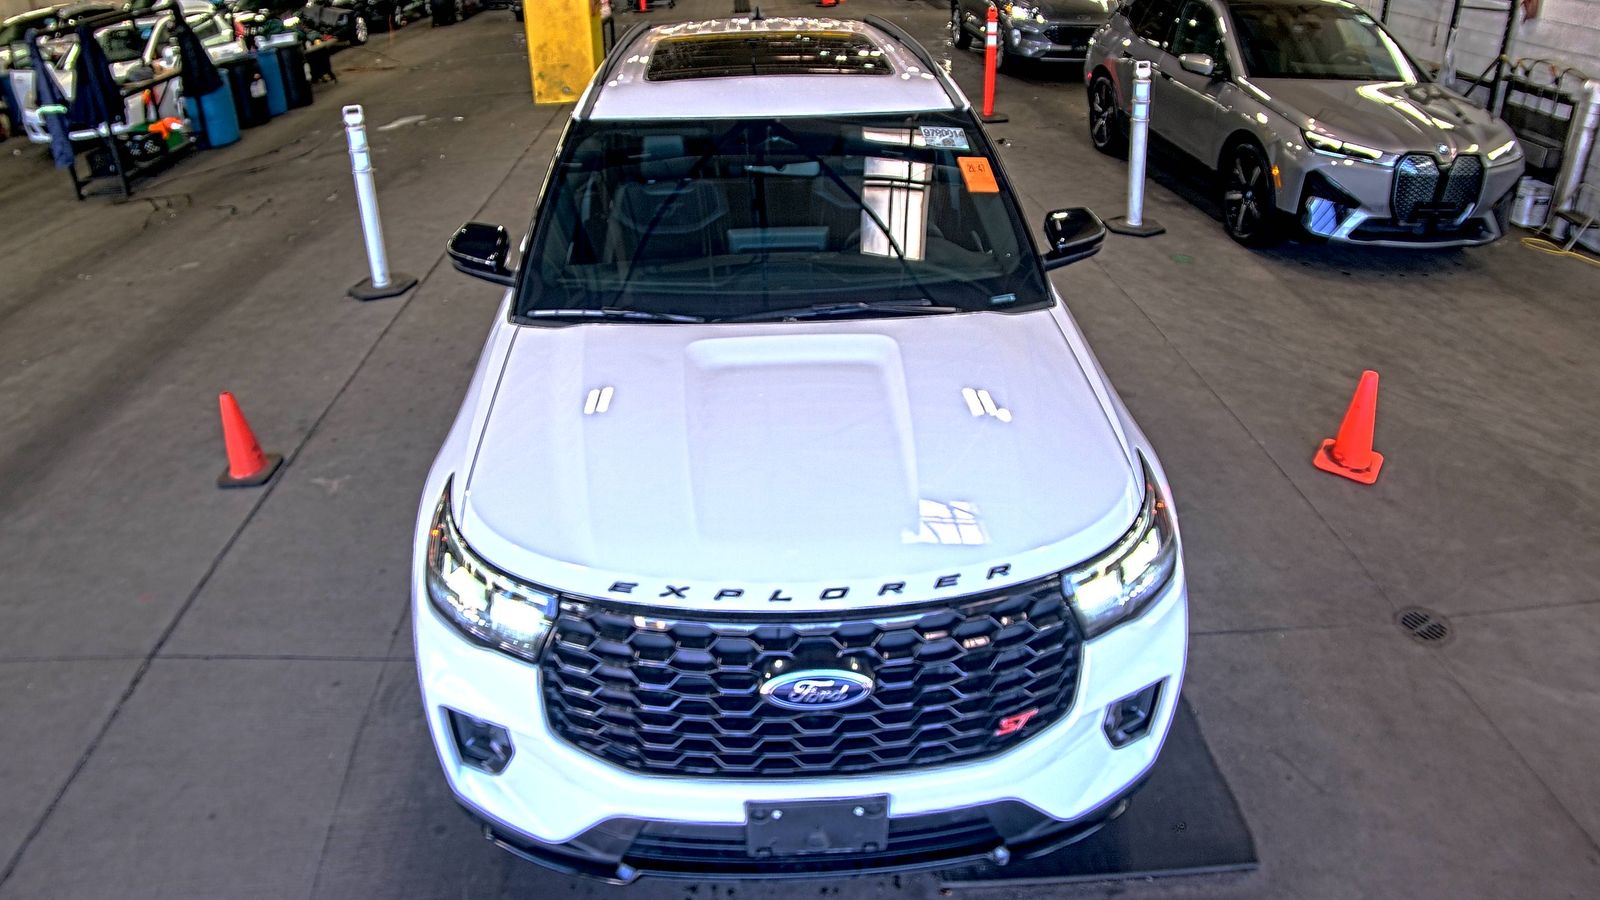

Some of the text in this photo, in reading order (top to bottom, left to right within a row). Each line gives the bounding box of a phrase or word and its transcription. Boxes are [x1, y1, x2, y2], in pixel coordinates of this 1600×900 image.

[608, 564, 1011, 602] EXPLORER
[789, 679, 850, 704] Ford
[994, 709, 1039, 737] ST
